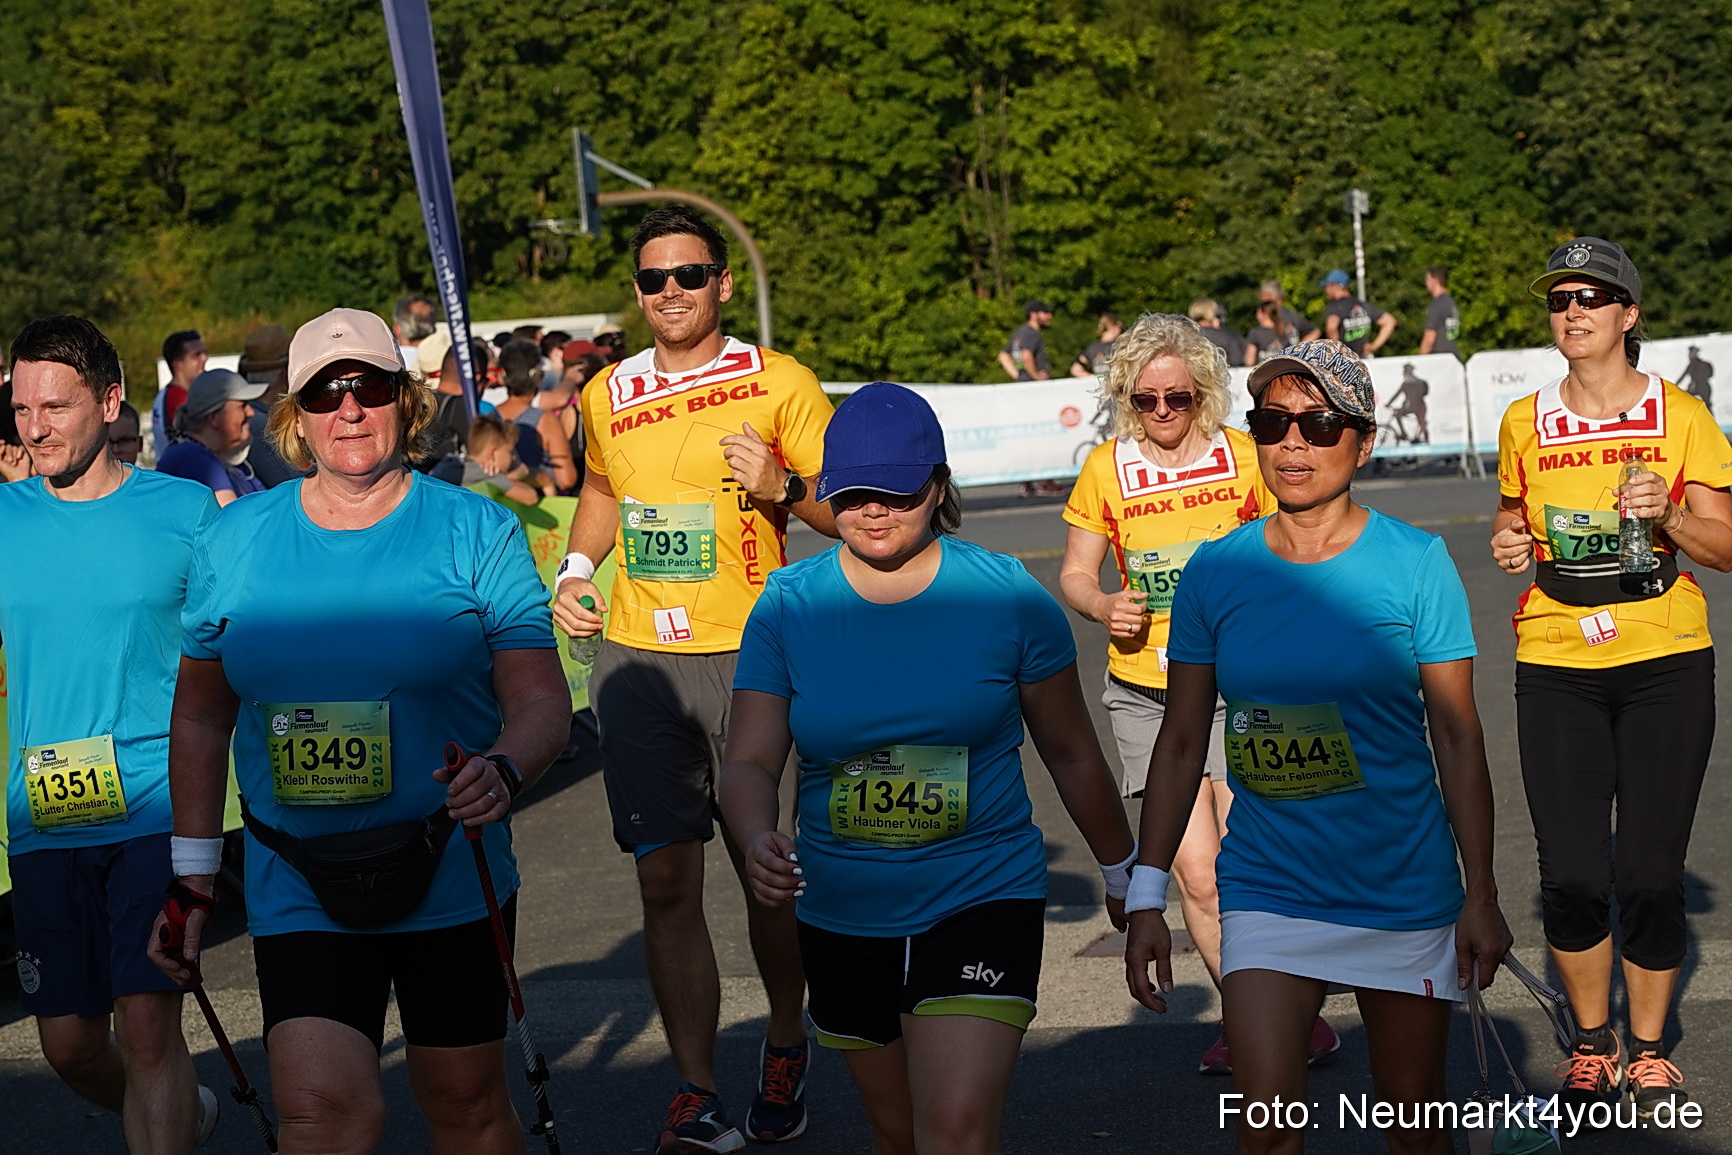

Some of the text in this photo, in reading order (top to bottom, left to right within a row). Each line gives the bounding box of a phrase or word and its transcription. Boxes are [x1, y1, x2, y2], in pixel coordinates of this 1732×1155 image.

[610, 382, 769, 438] MAX BÖGL
[1538, 443, 1668, 472] MAX BÖGL
[1123, 487, 1242, 520] MAX BÖGL
[628, 538, 637, 564] RUN
[640, 530, 688, 556] 793
[700, 534, 711, 569] 2022
[1568, 533, 1620, 558] 796
[636, 556, 701, 567] Schmidt Patrick
[290, 720, 329, 730] Firmenlauf
[1249, 722, 1284, 730] Firmenlauf
[40, 757, 69, 769] Firmenlauf
[271, 743, 282, 790] WALK
[282, 738, 367, 771] 1349
[371, 742, 384, 788] 2022
[1230, 740, 1249, 785] WALK
[1244, 736, 1332, 770] 1344
[1330, 738, 1354, 778] 2022
[37, 768, 100, 803] 1351
[103, 770, 120, 809] 2022
[283, 774, 368, 786] Klebl Roswitha
[1246, 768, 1340, 782] Haubner Felomina
[29, 780, 41, 820] WALK
[40, 798, 108, 816] Lutter Christian
[836, 782, 850, 829] WALK
[853, 779, 944, 816] 1345
[948, 788, 960, 832] 2022
[854, 816, 941, 830] Haubner Viola
[960, 962, 1004, 988] sky
